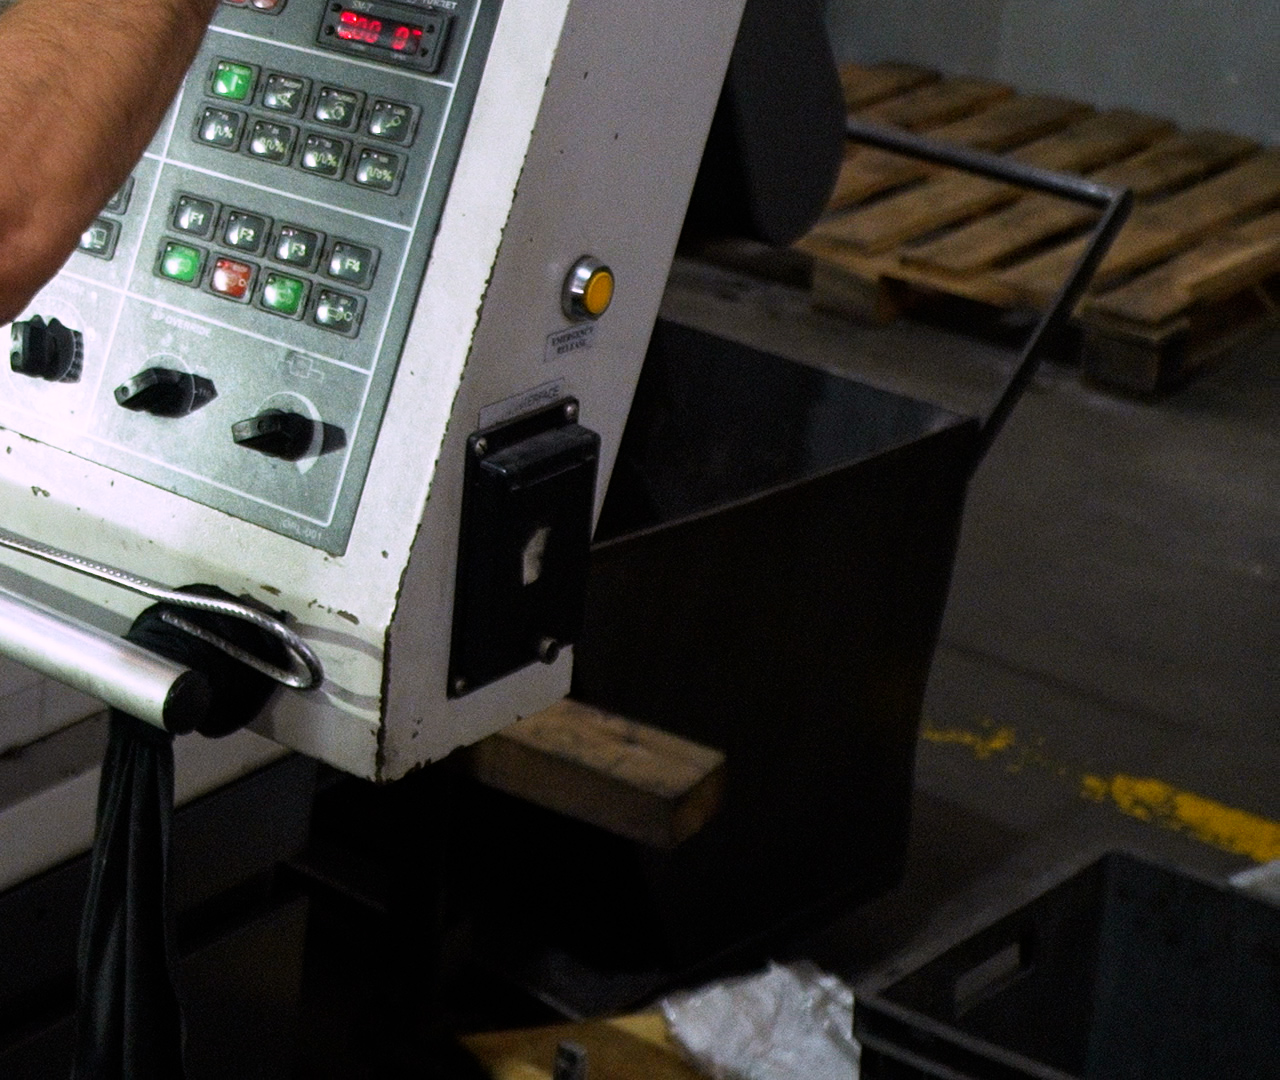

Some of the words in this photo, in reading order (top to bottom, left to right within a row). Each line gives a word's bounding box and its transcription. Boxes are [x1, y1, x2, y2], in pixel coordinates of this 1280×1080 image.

[189, 212, 204, 225] F1
[240, 229, 254, 242] F2
[292, 243, 306, 257] F3
[345, 260, 361, 273] F4
[165, 315, 213, 338] OVERRIDE
